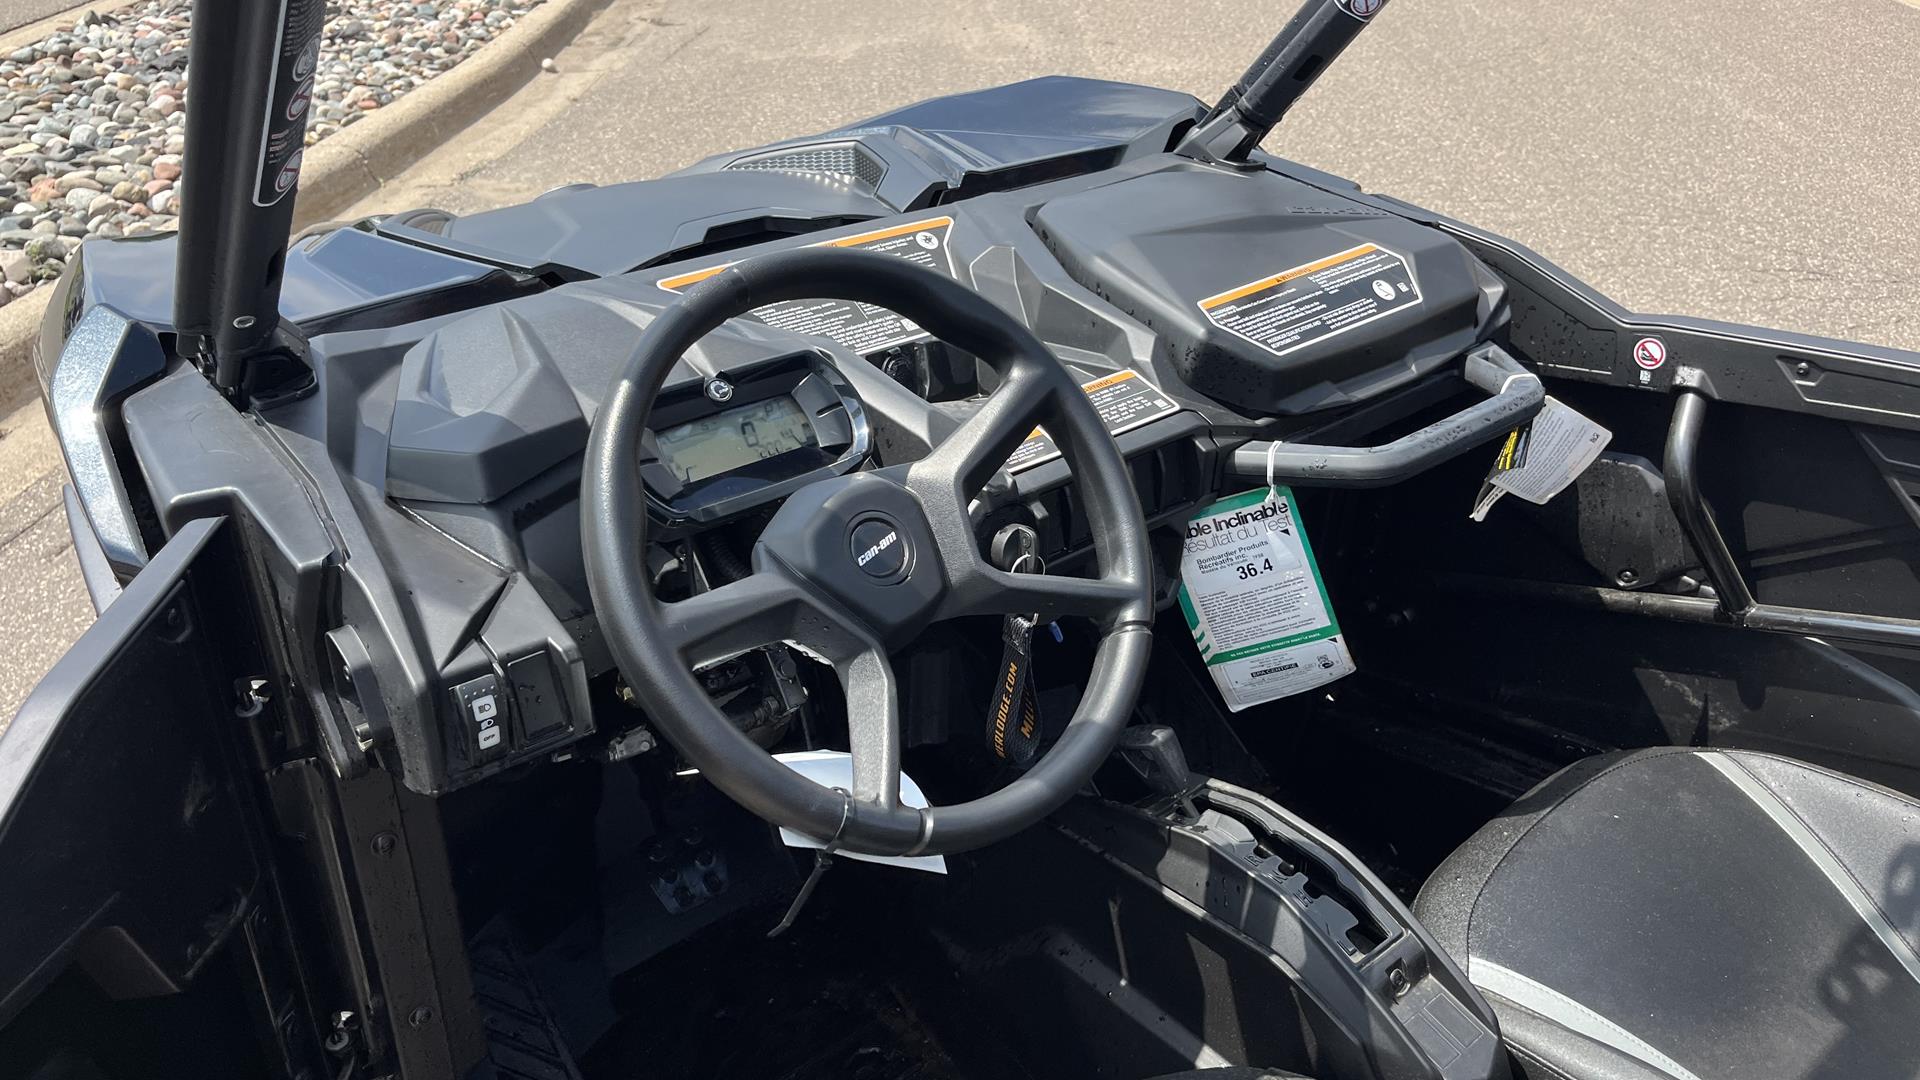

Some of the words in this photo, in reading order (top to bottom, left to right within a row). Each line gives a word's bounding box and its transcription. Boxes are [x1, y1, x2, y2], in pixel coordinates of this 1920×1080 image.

[1212, 500, 1288, 532] Inclinable
[1237, 525, 1258, 540] du
[1262, 514, 1293, 533] Test
[857, 531, 897, 567] can-am
[1196, 549, 1238, 566] Bombardier
[1238, 540, 1269, 553] Produits
[1236, 558, 1273, 580] 36.4
[483, 734, 496, 742] OFF
